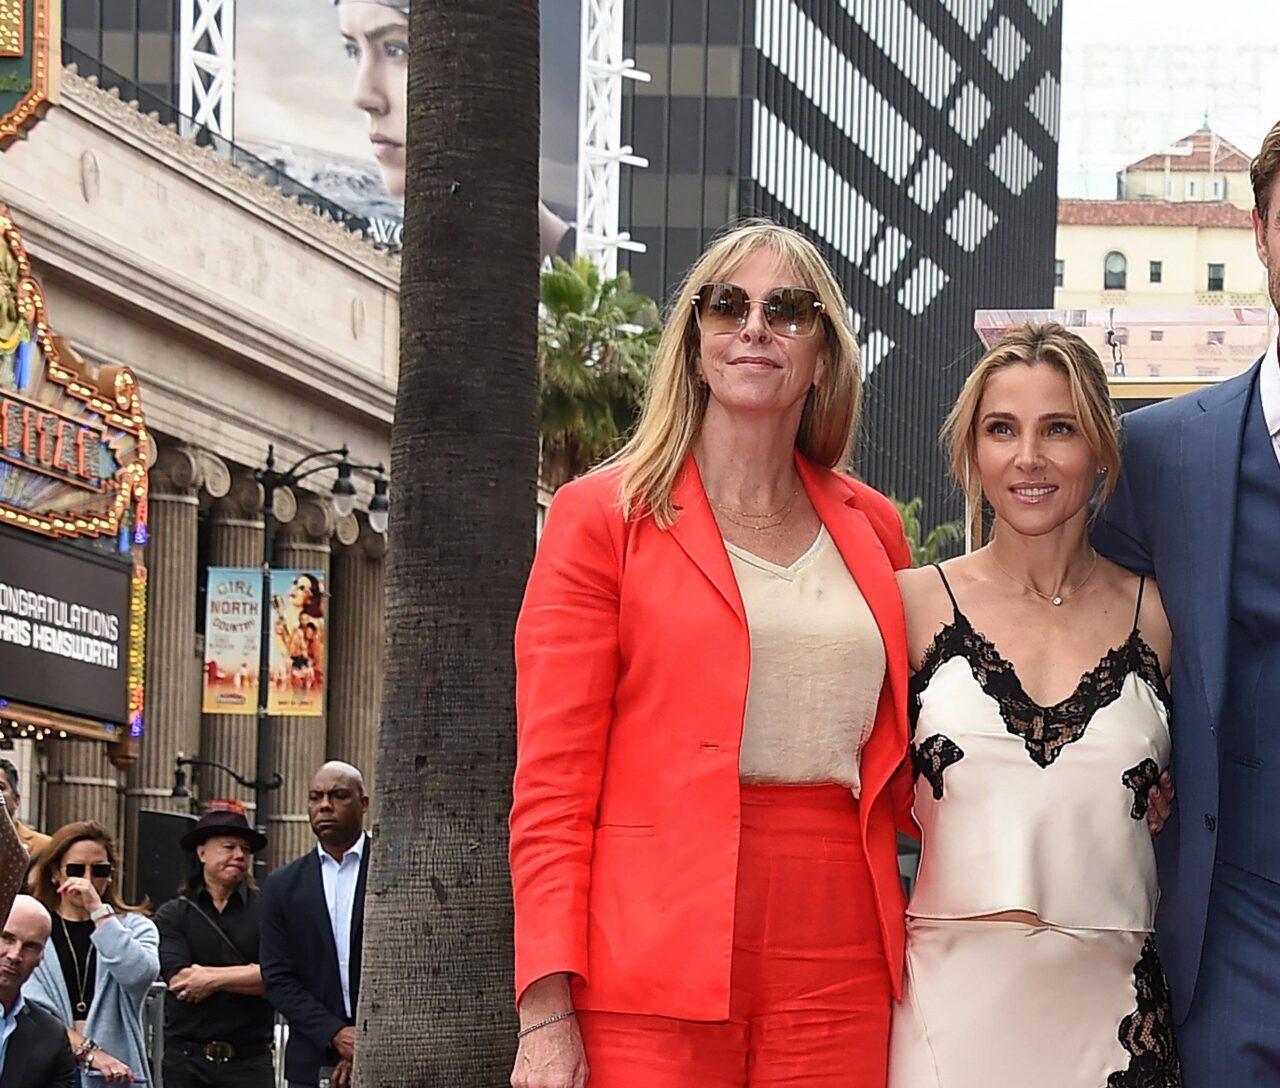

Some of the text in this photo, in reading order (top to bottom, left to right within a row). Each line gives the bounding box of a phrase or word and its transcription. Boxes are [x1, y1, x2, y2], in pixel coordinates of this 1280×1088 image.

[216, 580, 254, 598] GIRL
[210, 600, 259, 615] NORTH
[212, 617, 255, 633] COUNTRY
[32, 622, 119, 670] HEMSWORTH
